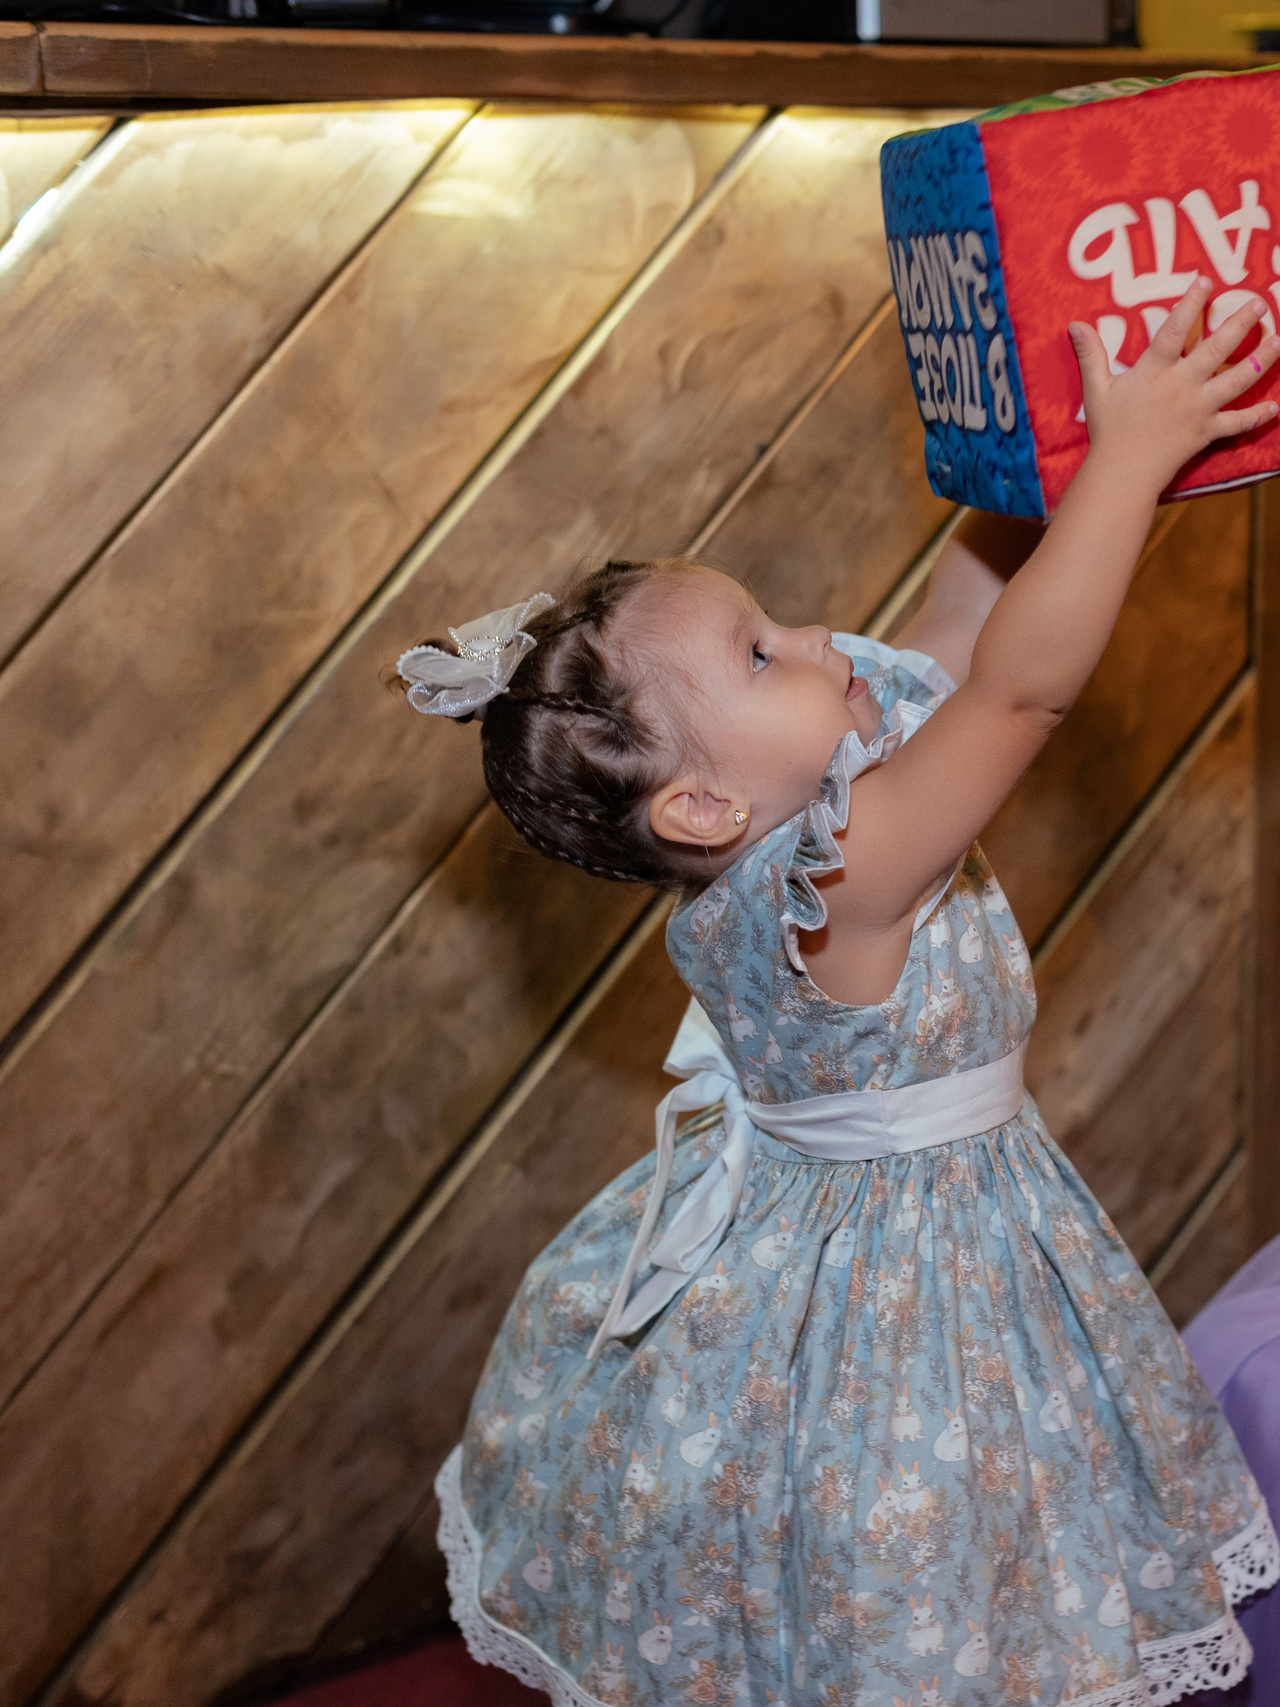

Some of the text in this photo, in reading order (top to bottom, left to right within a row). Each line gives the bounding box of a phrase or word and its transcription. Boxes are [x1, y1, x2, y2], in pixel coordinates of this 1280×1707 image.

[887, 229, 998, 331] ЗАМРИ
[908, 332, 1016, 433] В ПОЗЕ
